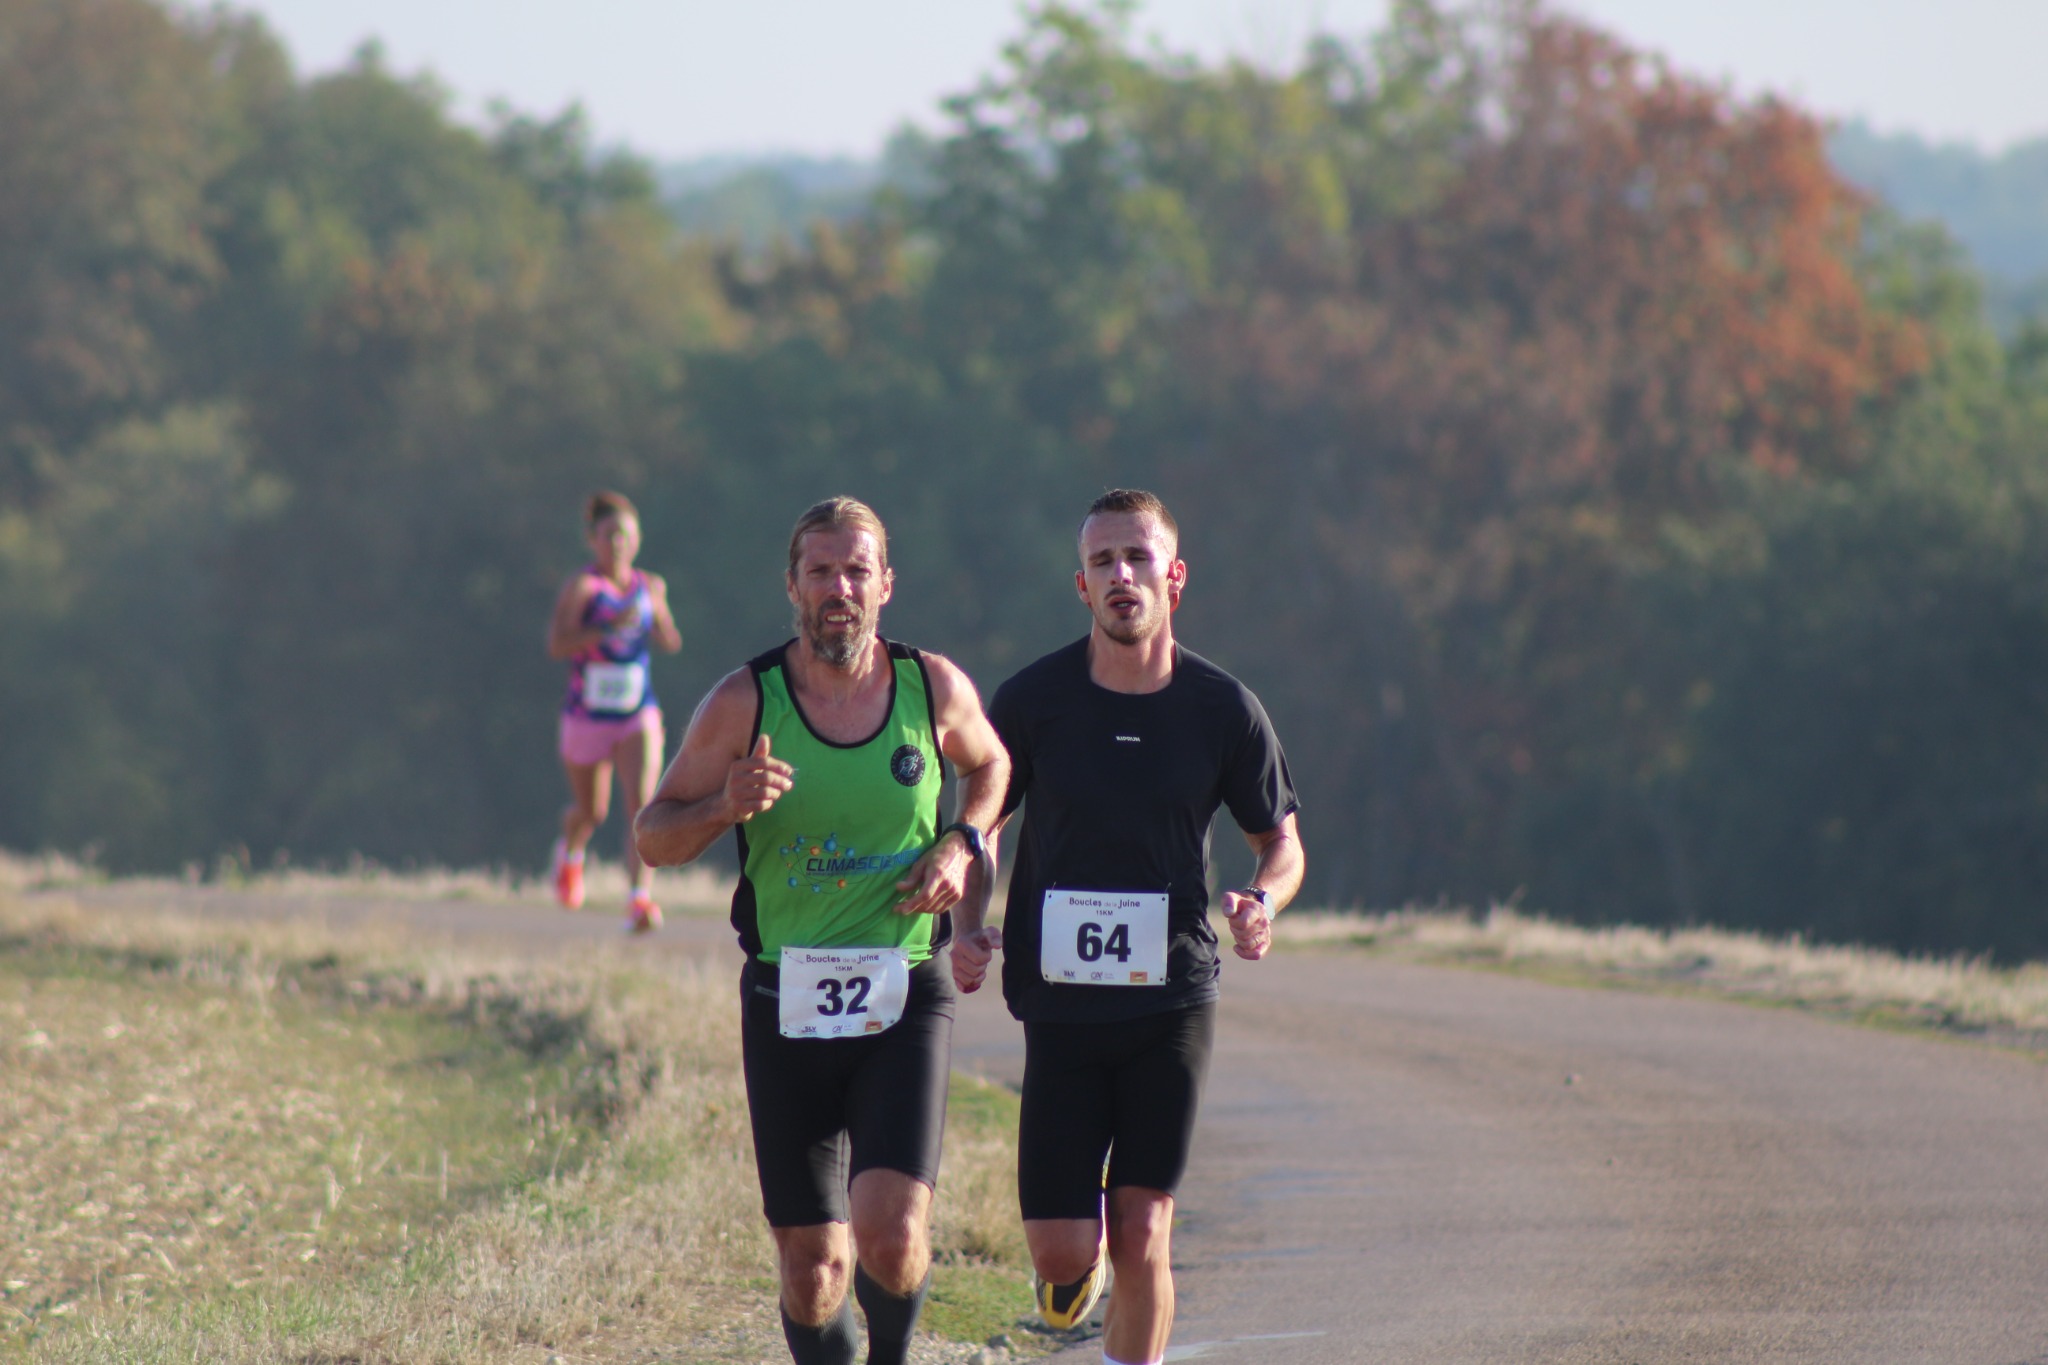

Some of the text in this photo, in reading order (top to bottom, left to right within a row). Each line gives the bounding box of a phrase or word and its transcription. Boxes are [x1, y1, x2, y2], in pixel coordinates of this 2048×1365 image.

[1069, 897, 1102, 907] Boucles
[1077, 922, 1131, 962] 64
[806, 954, 840, 963] Boucles
[816, 976, 872, 1017] 32
